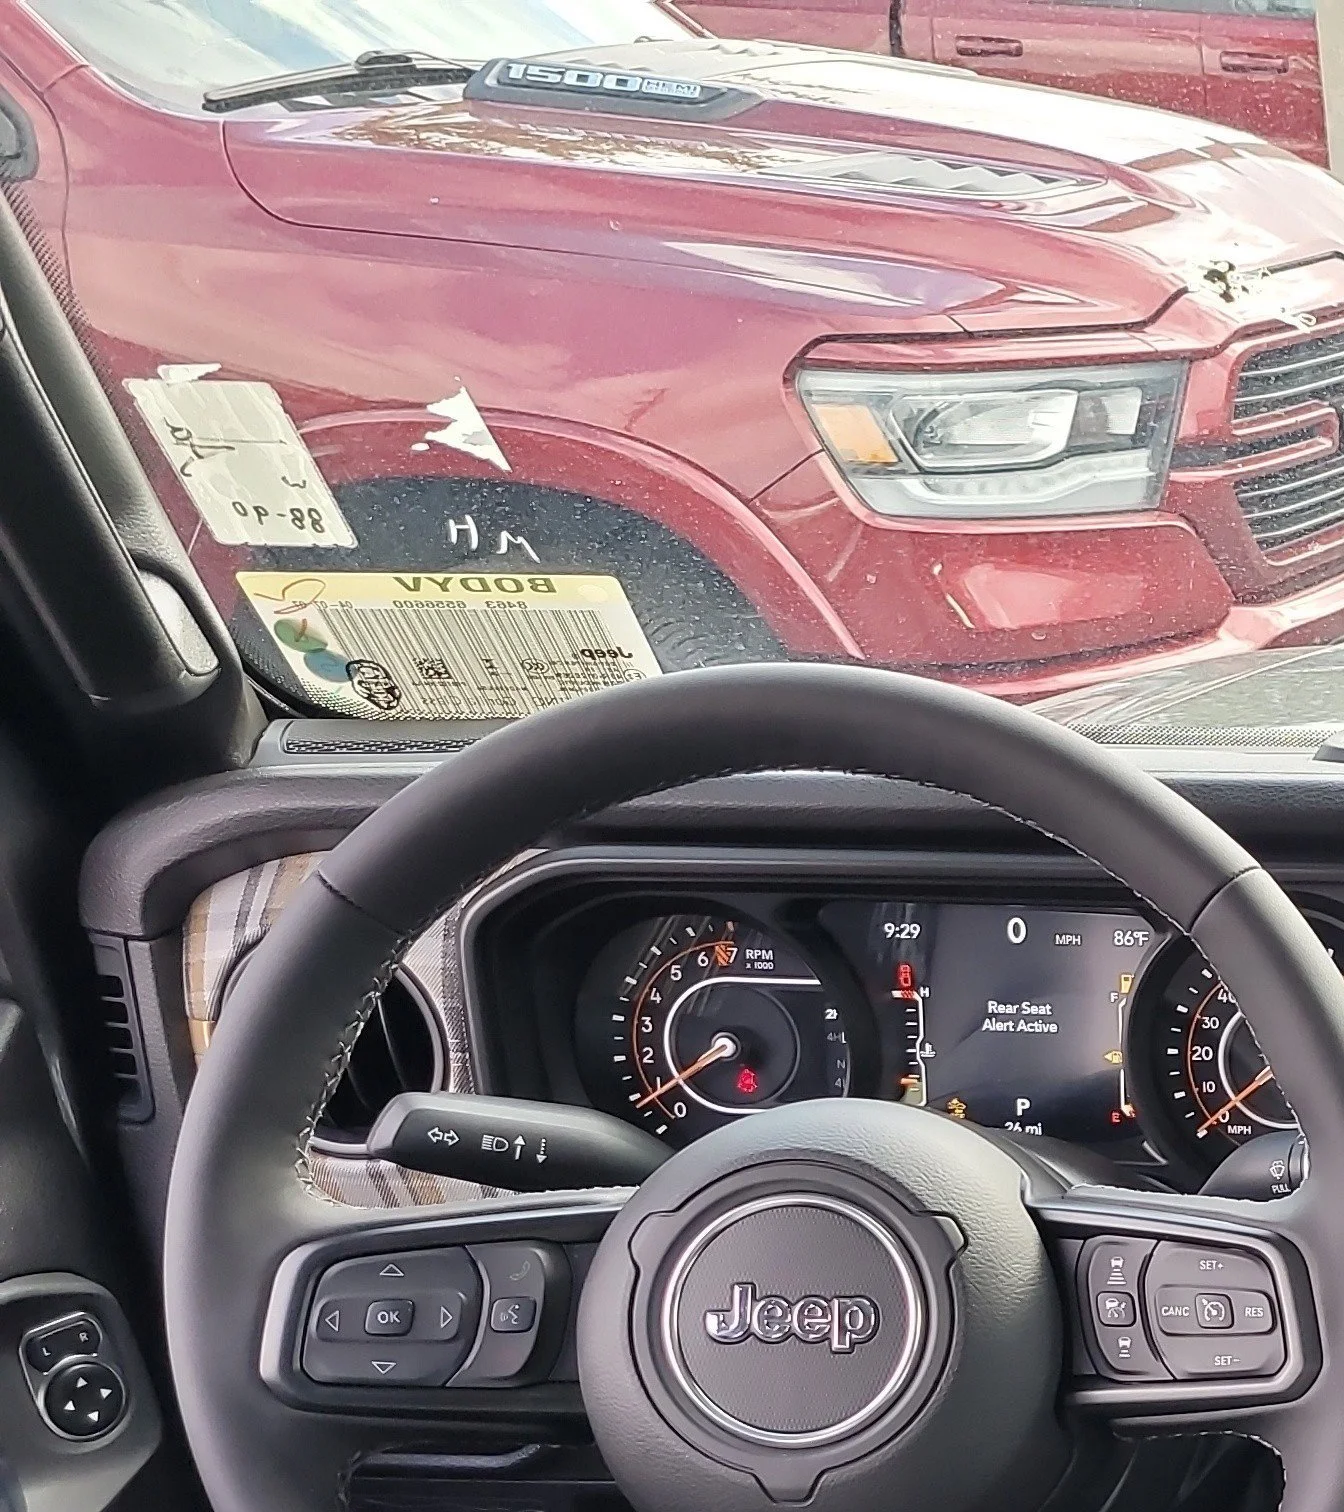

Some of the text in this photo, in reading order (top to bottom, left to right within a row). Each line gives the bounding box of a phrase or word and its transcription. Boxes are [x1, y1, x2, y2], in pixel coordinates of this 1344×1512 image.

[507, 63, 643, 93] 1500
[884, 922, 922, 939] 9:29
[1006, 917, 1082, 946] 0 MPH
[697, 951, 709, 967] 6
[745, 949, 774, 960] RPM
[753, 961, 774, 970] 1000
[670, 965, 682, 981] 5
[650, 987, 662, 1003] 4
[919, 986, 930, 998] H
[1110, 992, 1119, 1003] F
[987, 1000, 1053, 1015] Rear Seat
[641, 1017, 653, 1033] 3
[982, 1018, 1058, 1033] Alert Active
[1201, 1016, 1220, 1029] 30
[642, 1047, 655, 1063] 2
[1191, 1046, 1214, 1061] 20
[1202, 1080, 1216, 1093] 10
[673, 1101, 687, 1118] 0
[1016, 1098, 1031, 1117] P
[1111, 1112, 1121, 1123] E
[1227, 1125, 1252, 1135] MPH
[1271, 1183, 1291, 1194] PULL
[377, 1310, 401, 1324] OK
[704, 1282, 880, 1354] Jeep
[1161, 1306, 1190, 1317] CANC
[1245, 1307, 1264, 1318] RES
[79, 1332, 89, 1342] R
[42, 1347, 51, 1356] L
